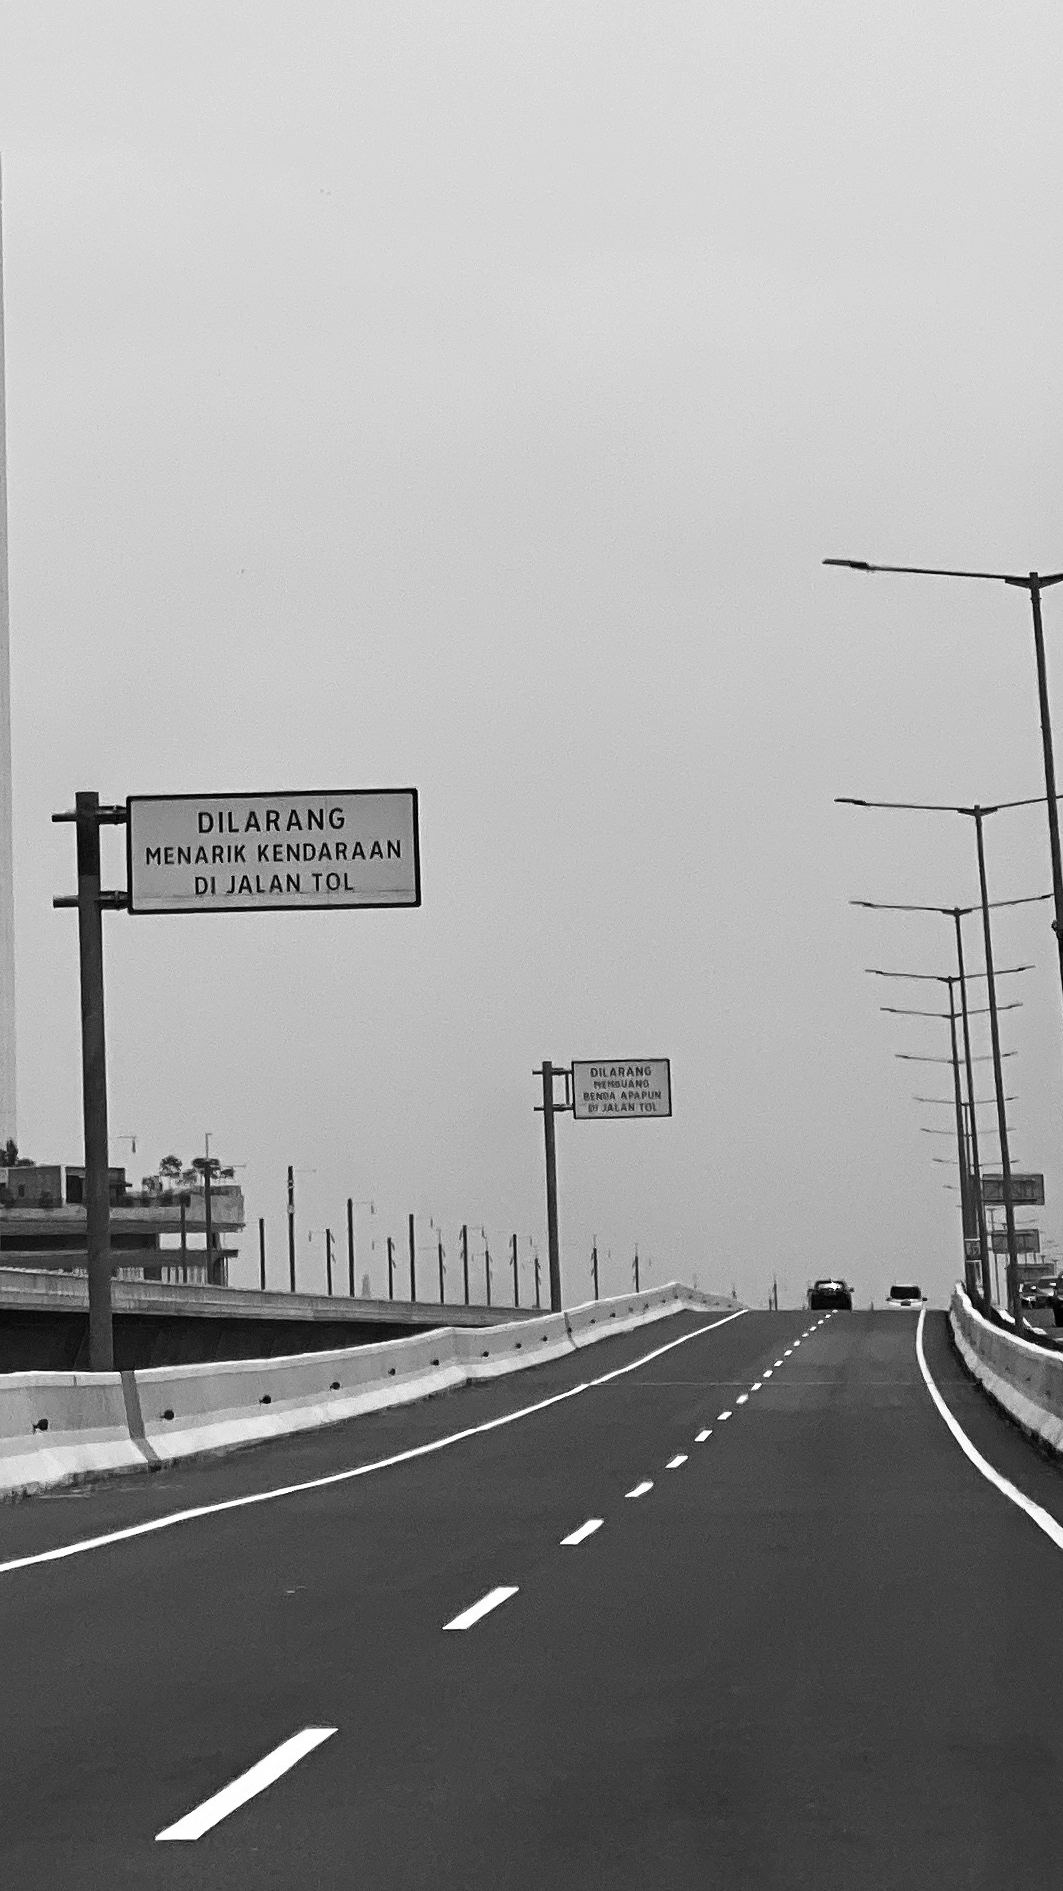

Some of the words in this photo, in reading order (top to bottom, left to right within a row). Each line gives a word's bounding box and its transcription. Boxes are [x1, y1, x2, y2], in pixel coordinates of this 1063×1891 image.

[198, 807, 346, 834] DILARANG
[145, 844, 247, 866] MENARIK
[257, 839, 402, 863] KENDARAAN
[194, 876, 216, 896] DI
[226, 873, 301, 895] JALAN
[311, 872, 355, 892] TOL
[590, 1066, 652, 1078] DILARANG
[583, 1091, 616, 1102] BENDA
[620, 1090, 662, 1100] APAPUN
[602, 1102, 635, 1112] JALAN
[639, 1102, 657, 1112] TOL
